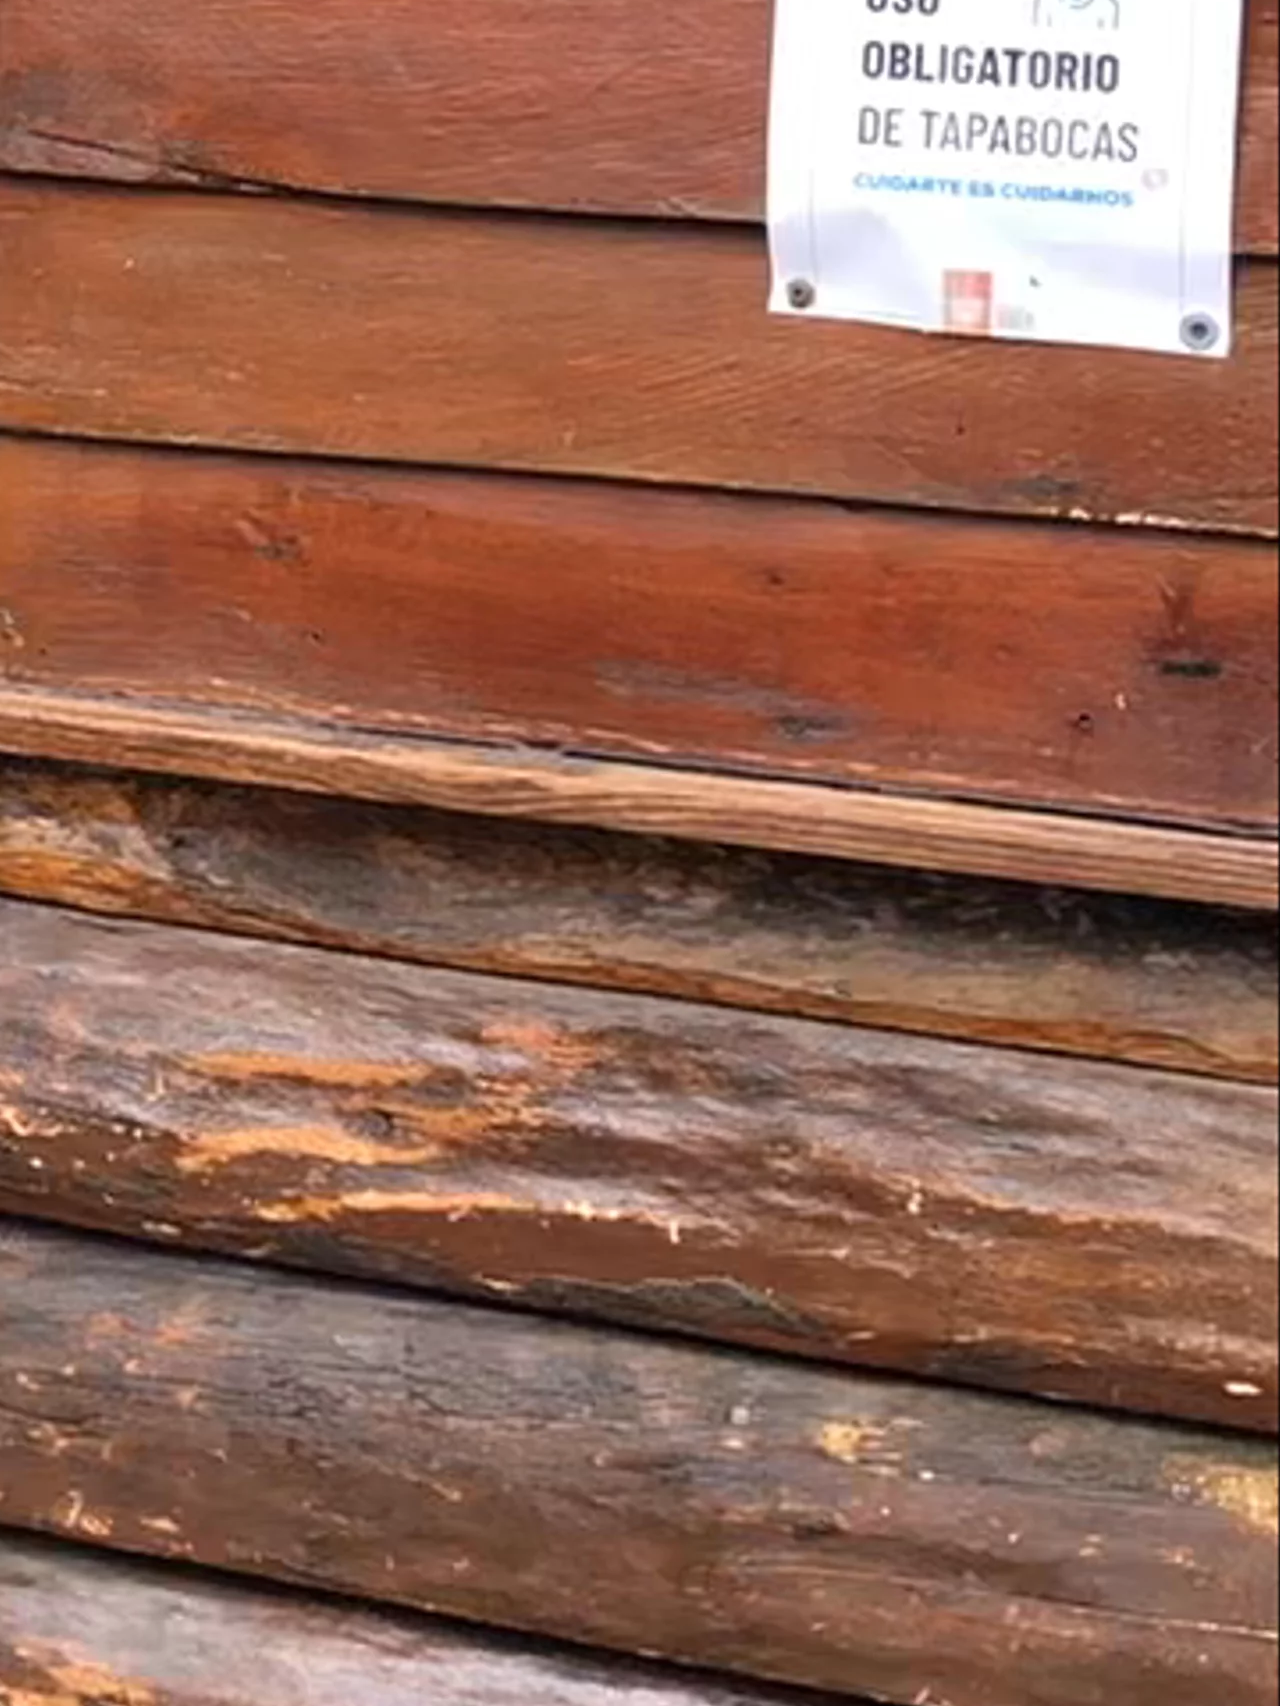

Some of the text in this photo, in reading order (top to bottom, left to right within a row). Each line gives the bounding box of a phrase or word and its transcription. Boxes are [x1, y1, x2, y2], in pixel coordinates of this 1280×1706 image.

[861, 40, 1120, 94] OBLIGATORIO
[857, 105, 1140, 163] DE TAPABOCAS
[852, 171, 1135, 208] CUIDARTE ES CUIDARNOS
